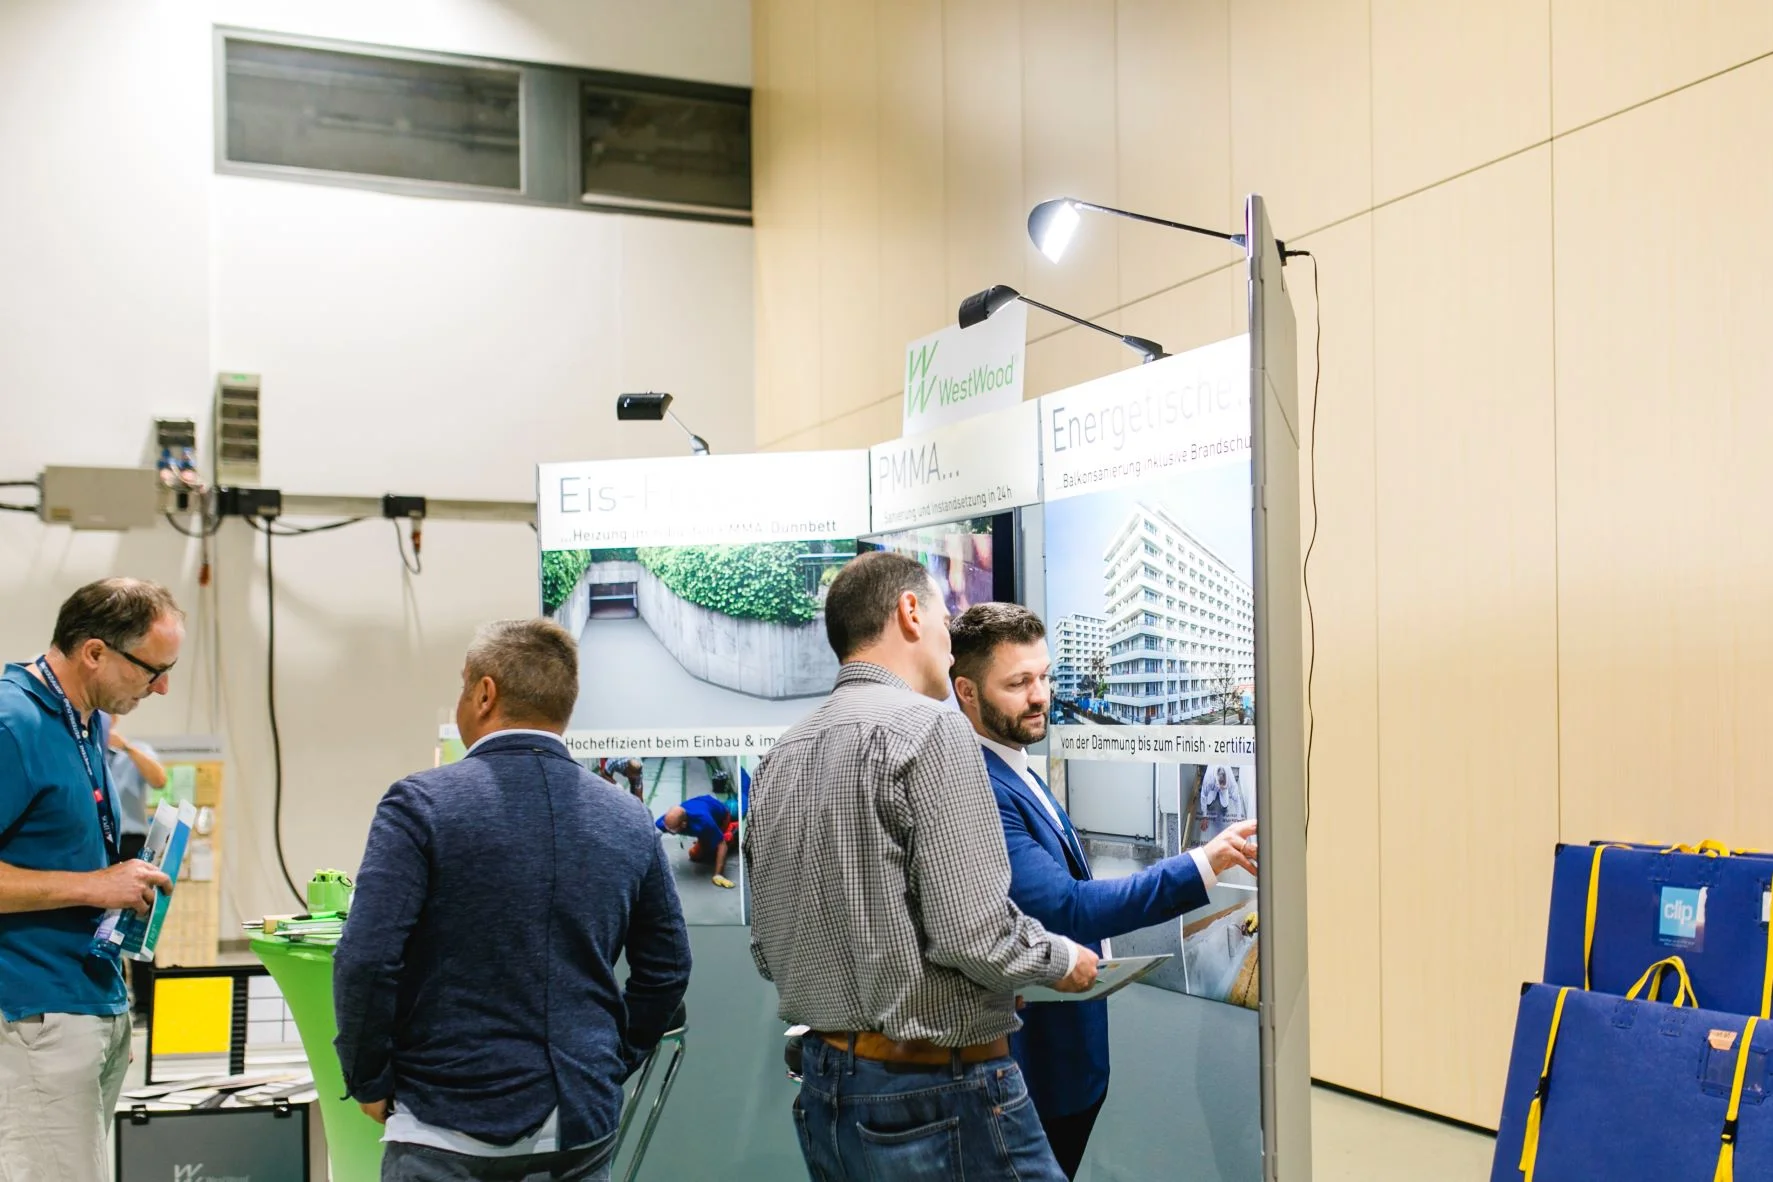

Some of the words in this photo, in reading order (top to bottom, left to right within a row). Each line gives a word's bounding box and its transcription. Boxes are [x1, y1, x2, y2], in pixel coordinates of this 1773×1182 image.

[938, 354, 1015, 407] WestWood
[918, 502, 931, 517] und
[987, 488, 996, 503] in
[565, 736, 652, 751] Hocheffizient
[655, 735, 690, 749] beim
[693, 734, 740, 748] Einbau
[744, 734, 754, 747] &
[1076, 733, 1090, 749] der
[1138, 735, 1151, 752] bis
[1153, 738, 1174, 753] zum
[1176, 735, 1206, 753] Finish
[1663, 899, 1693, 925] clip
